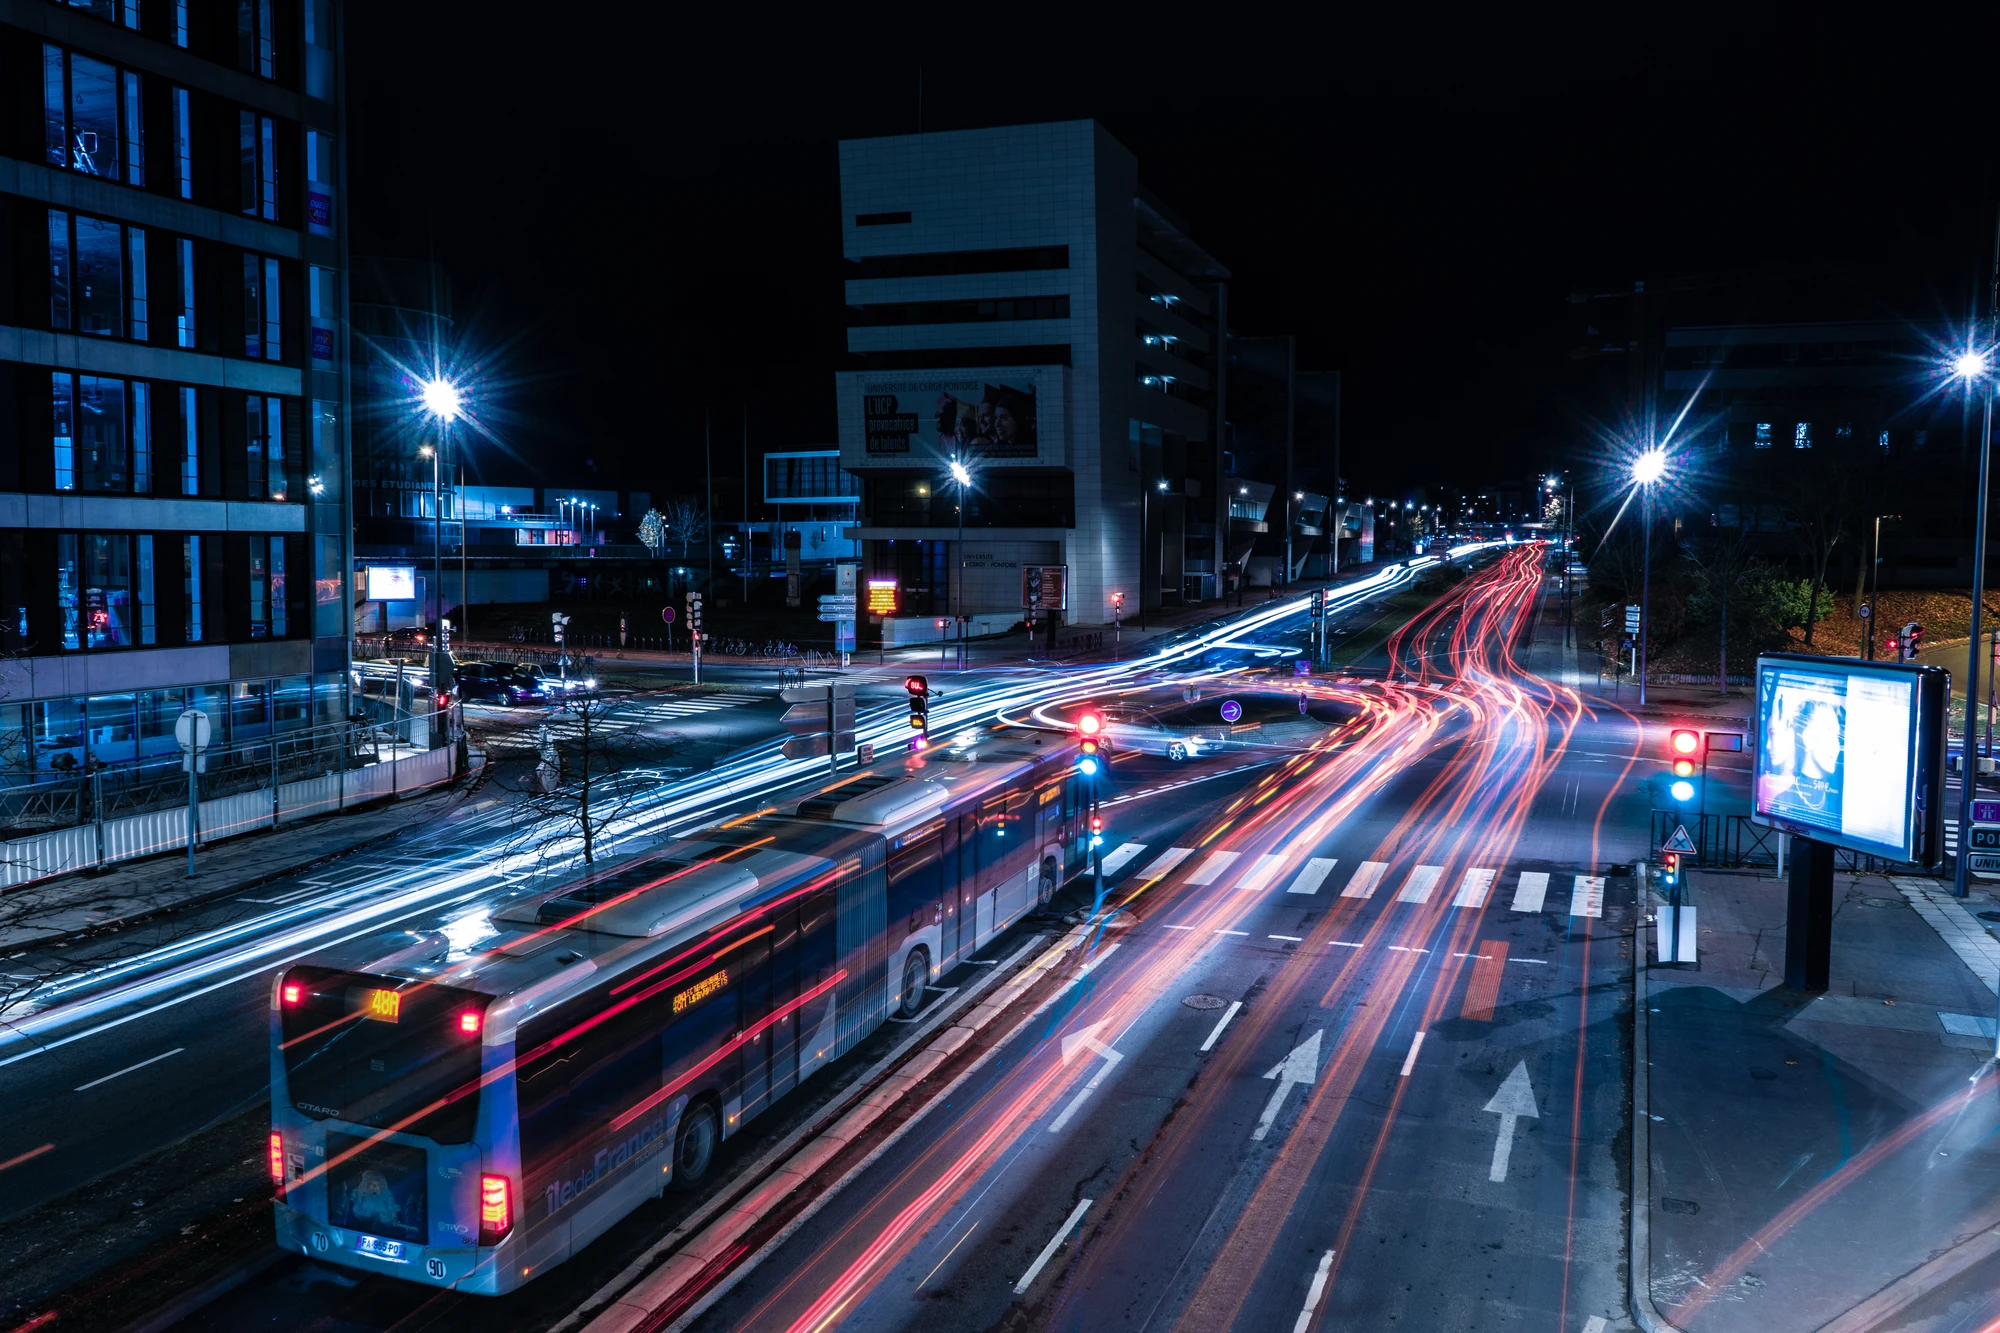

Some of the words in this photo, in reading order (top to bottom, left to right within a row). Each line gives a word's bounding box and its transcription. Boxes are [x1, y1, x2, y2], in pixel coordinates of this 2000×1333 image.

[867, 396, 892, 415] L'UCP
[869, 418, 916, 433] provocatrice
[870, 435, 880, 450] de
[880, 436, 906, 451] talents
[353, 479, 377, 488] DES
[1976, 832, 2000, 845] PO
[371, 988, 401, 1017] 48A
[297, 1101, 340, 1117] CITARO
[313, 1232, 328, 1251] 70
[461, 1236, 478, 1246] 864
[428, 1259, 444, 1278] 90
